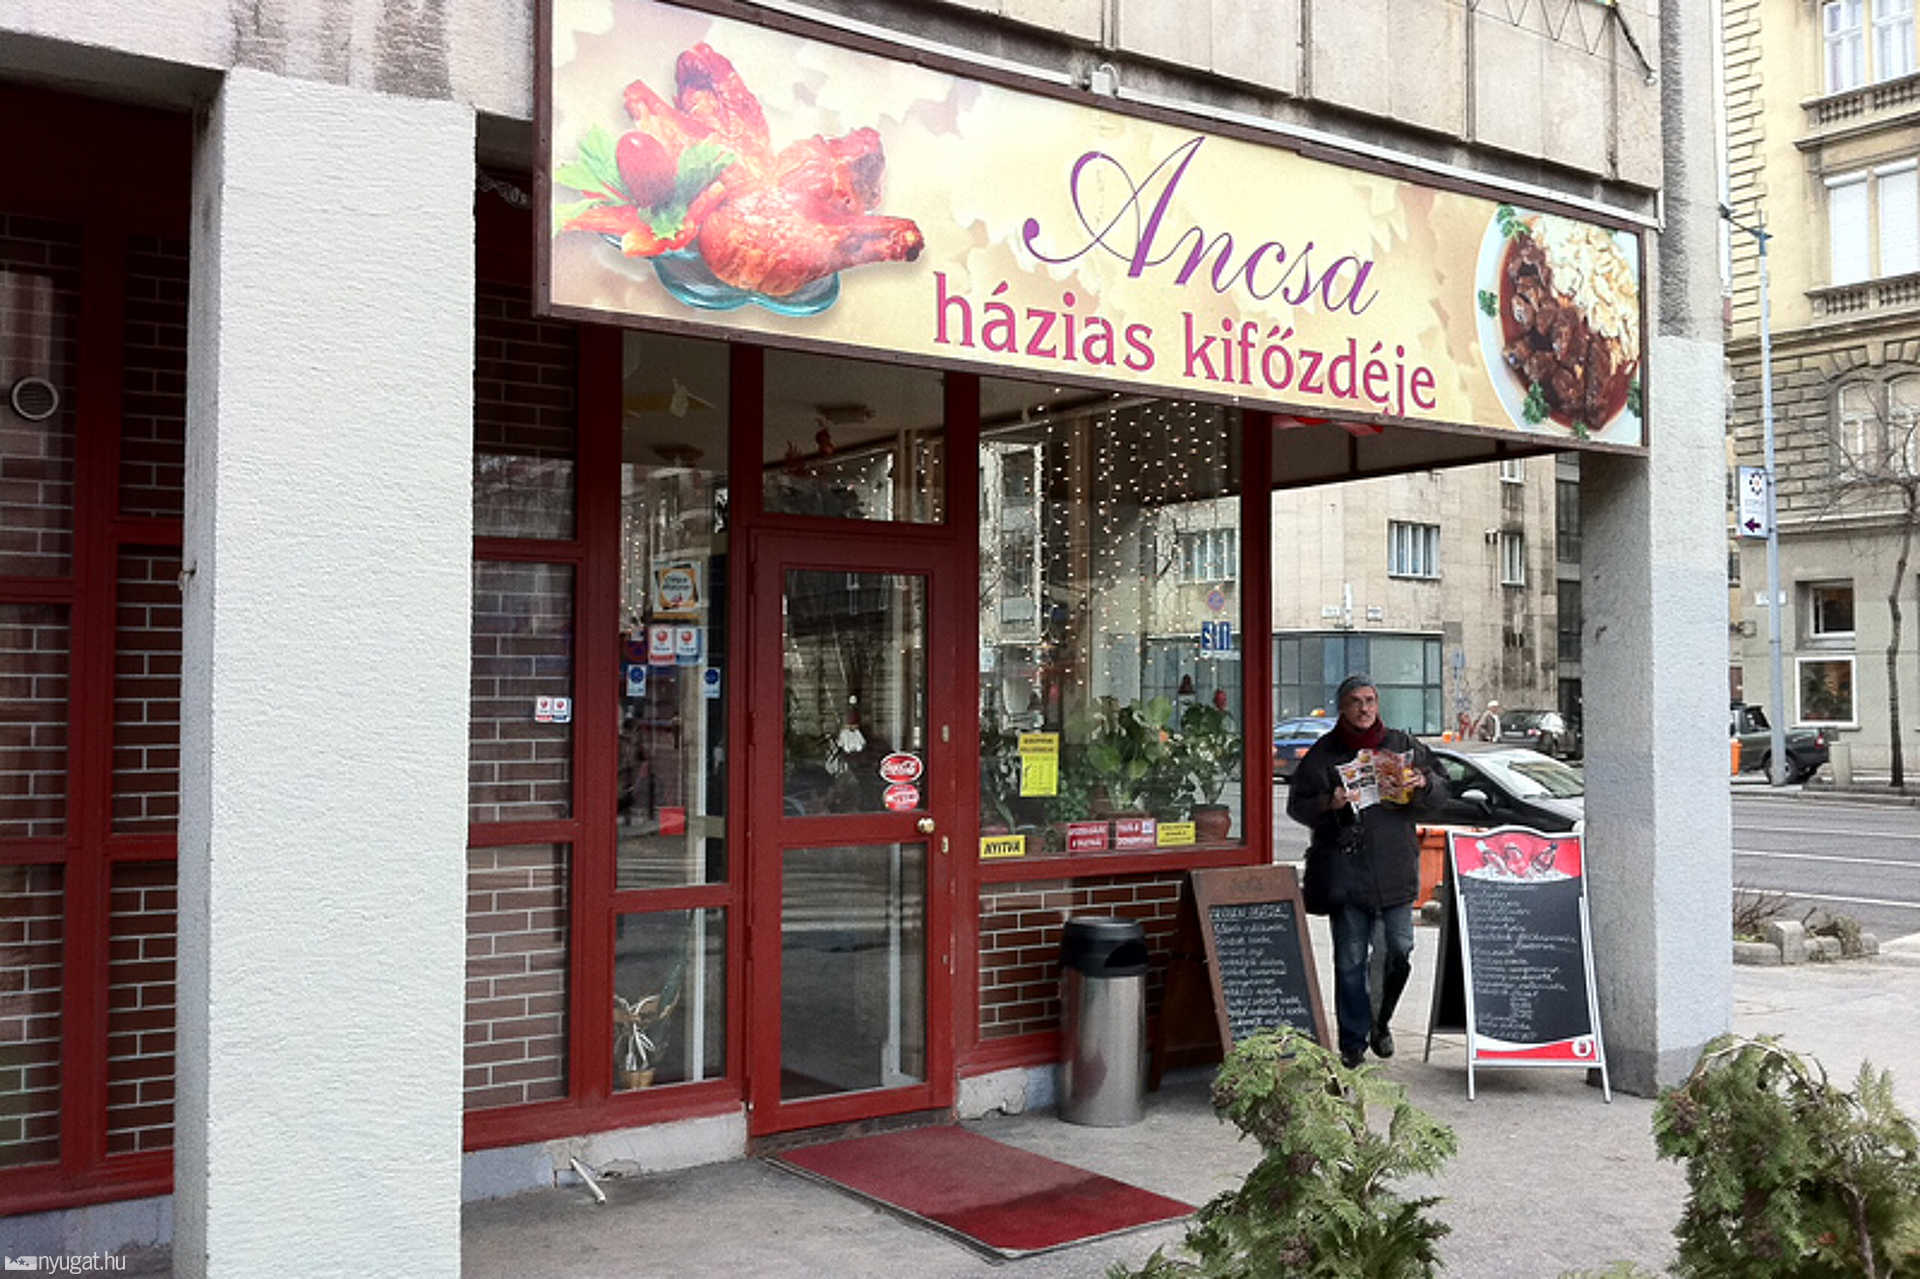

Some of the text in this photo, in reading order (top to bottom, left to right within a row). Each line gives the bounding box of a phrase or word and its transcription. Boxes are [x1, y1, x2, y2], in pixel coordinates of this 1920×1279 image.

[1022, 135, 1379, 316] Ancsa
[933, 271, 1438, 419] házias kifőzdéje
[984, 840, 1021, 855] NYITVA
